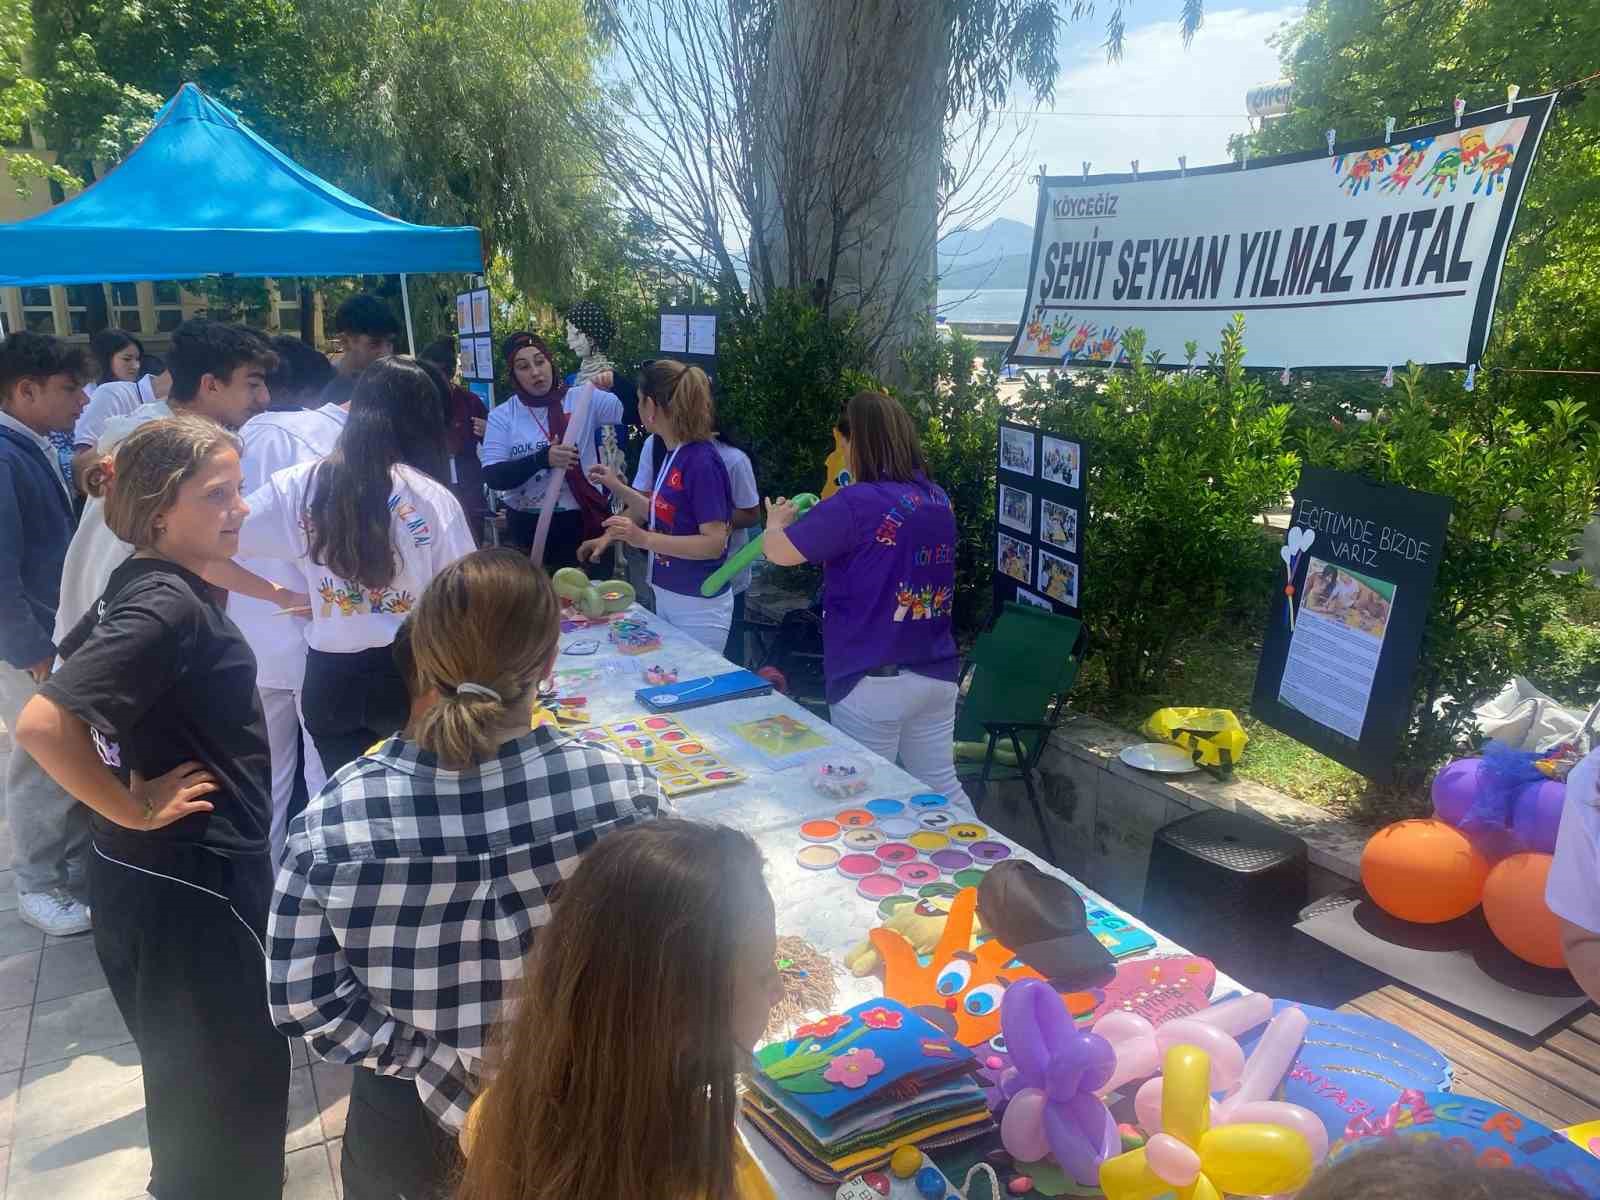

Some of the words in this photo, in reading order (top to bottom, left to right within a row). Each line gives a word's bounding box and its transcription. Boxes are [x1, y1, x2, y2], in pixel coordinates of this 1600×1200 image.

[1053, 192, 1119, 217] KÖYCEĞİZ
[1112, 234, 1231, 301] SEYHAN
[1233, 218, 1368, 299] YILMAZ
[1362, 201, 1476, 291] MTAL
[1330, 537, 1379, 568] VARIZ
[1379, 525, 1433, 564] BİZDE
[957, 830, 977, 838] 3
